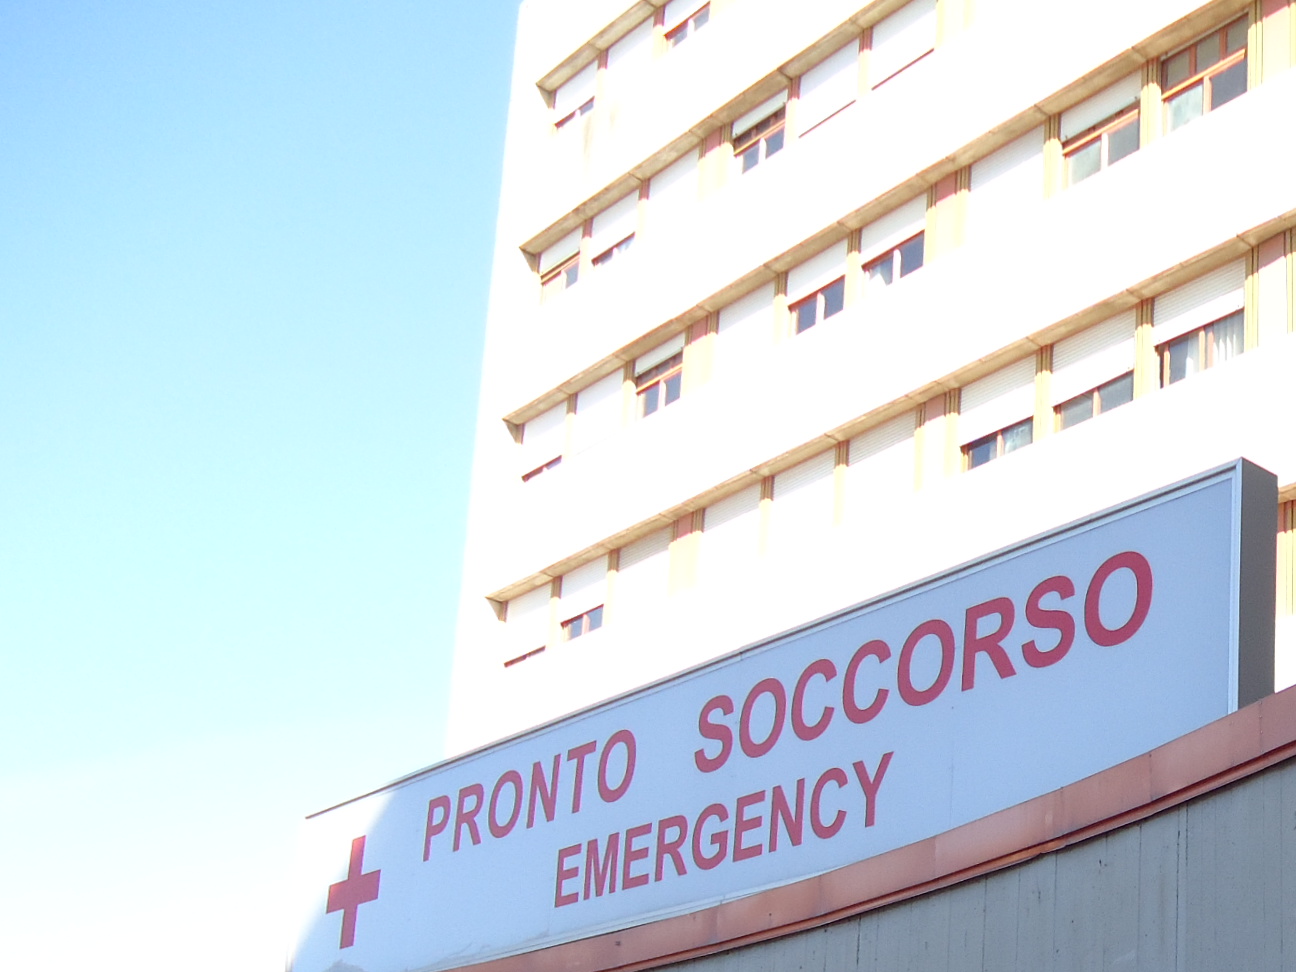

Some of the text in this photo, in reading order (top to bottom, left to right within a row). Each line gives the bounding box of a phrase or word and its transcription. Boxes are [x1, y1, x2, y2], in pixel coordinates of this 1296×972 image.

[423, 550, 1153, 862] PRONTO SOCCORSO
[553, 752, 894, 909] EMERGENCY
